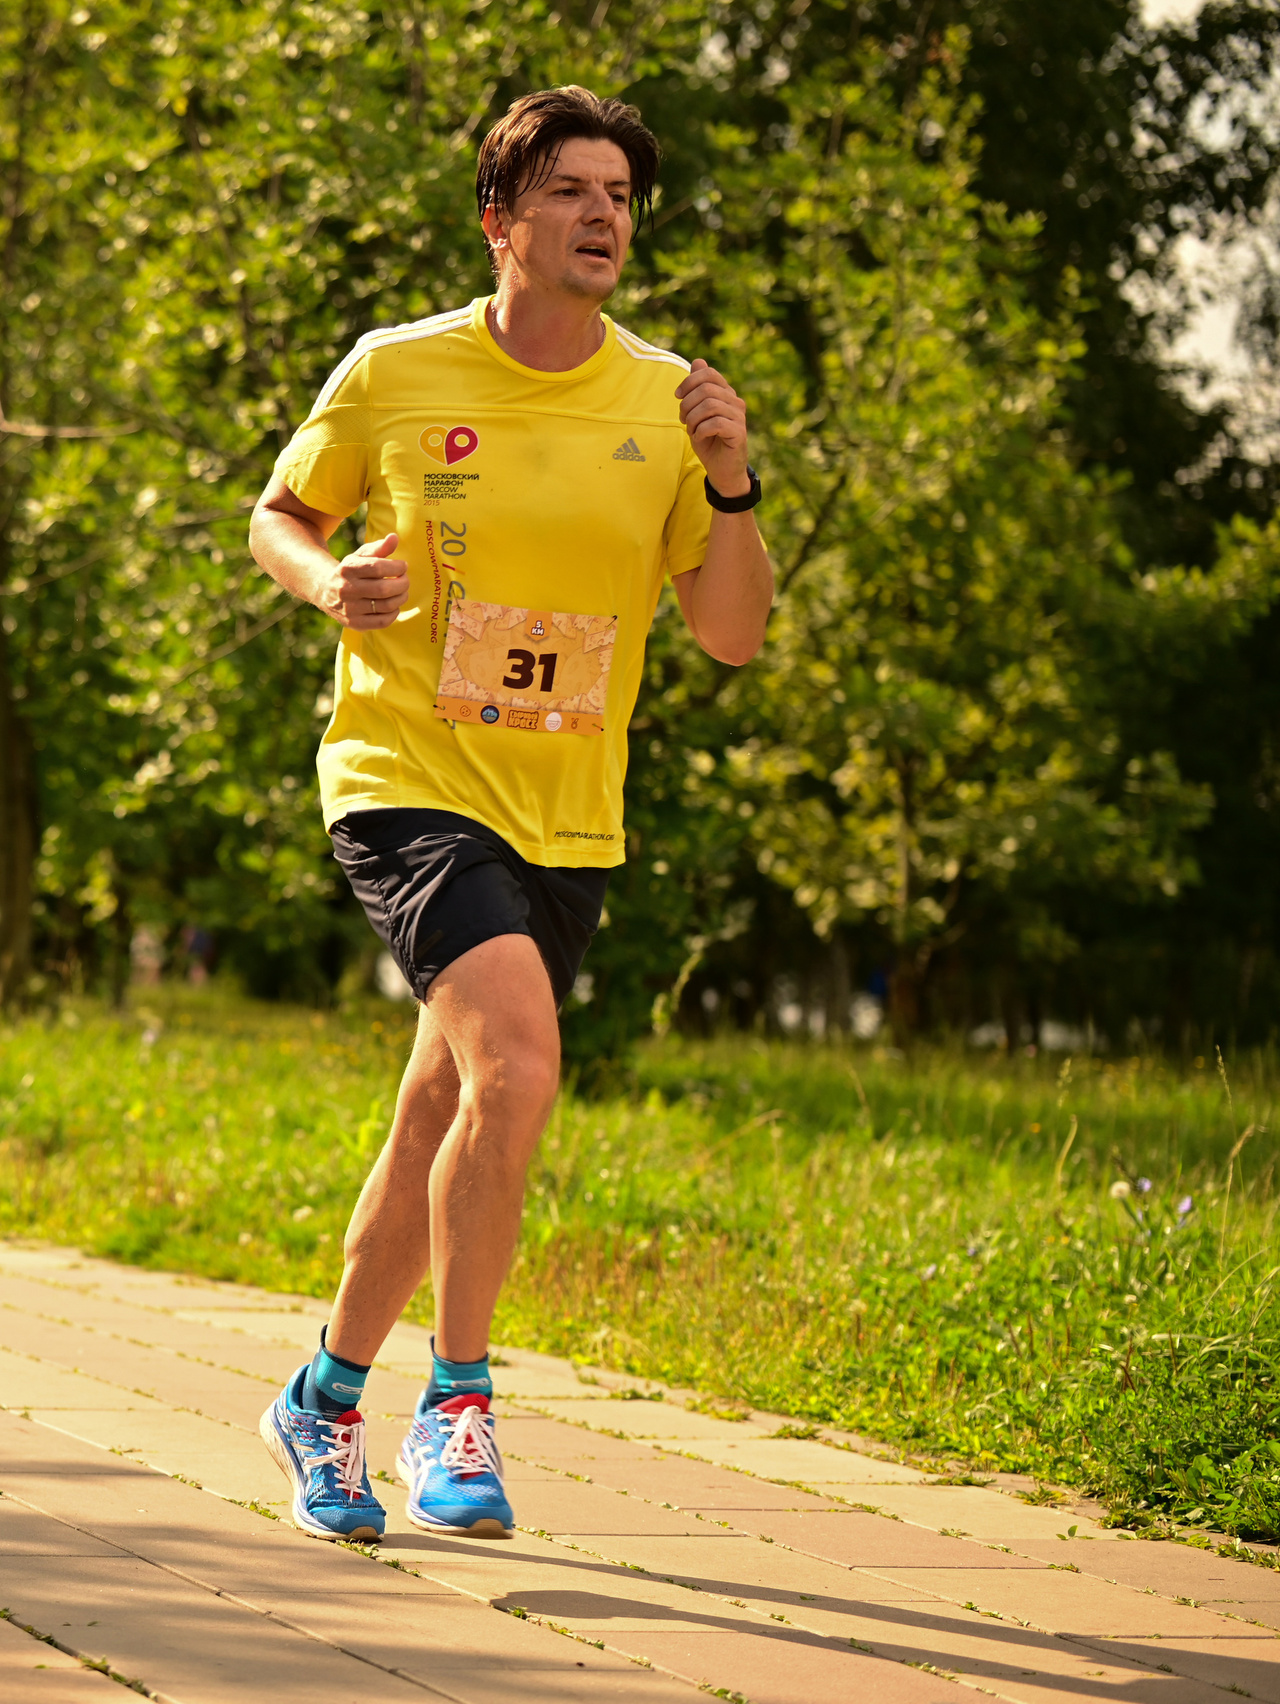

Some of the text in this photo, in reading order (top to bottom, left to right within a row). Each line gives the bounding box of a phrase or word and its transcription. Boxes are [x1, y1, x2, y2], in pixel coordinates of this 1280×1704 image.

[612, 452, 646, 462] adidas
[425, 520, 441, 643] MOSCOWMARATHON.ORG
[535, 620, 543, 628] 5
[502, 649, 558, 692] 31
